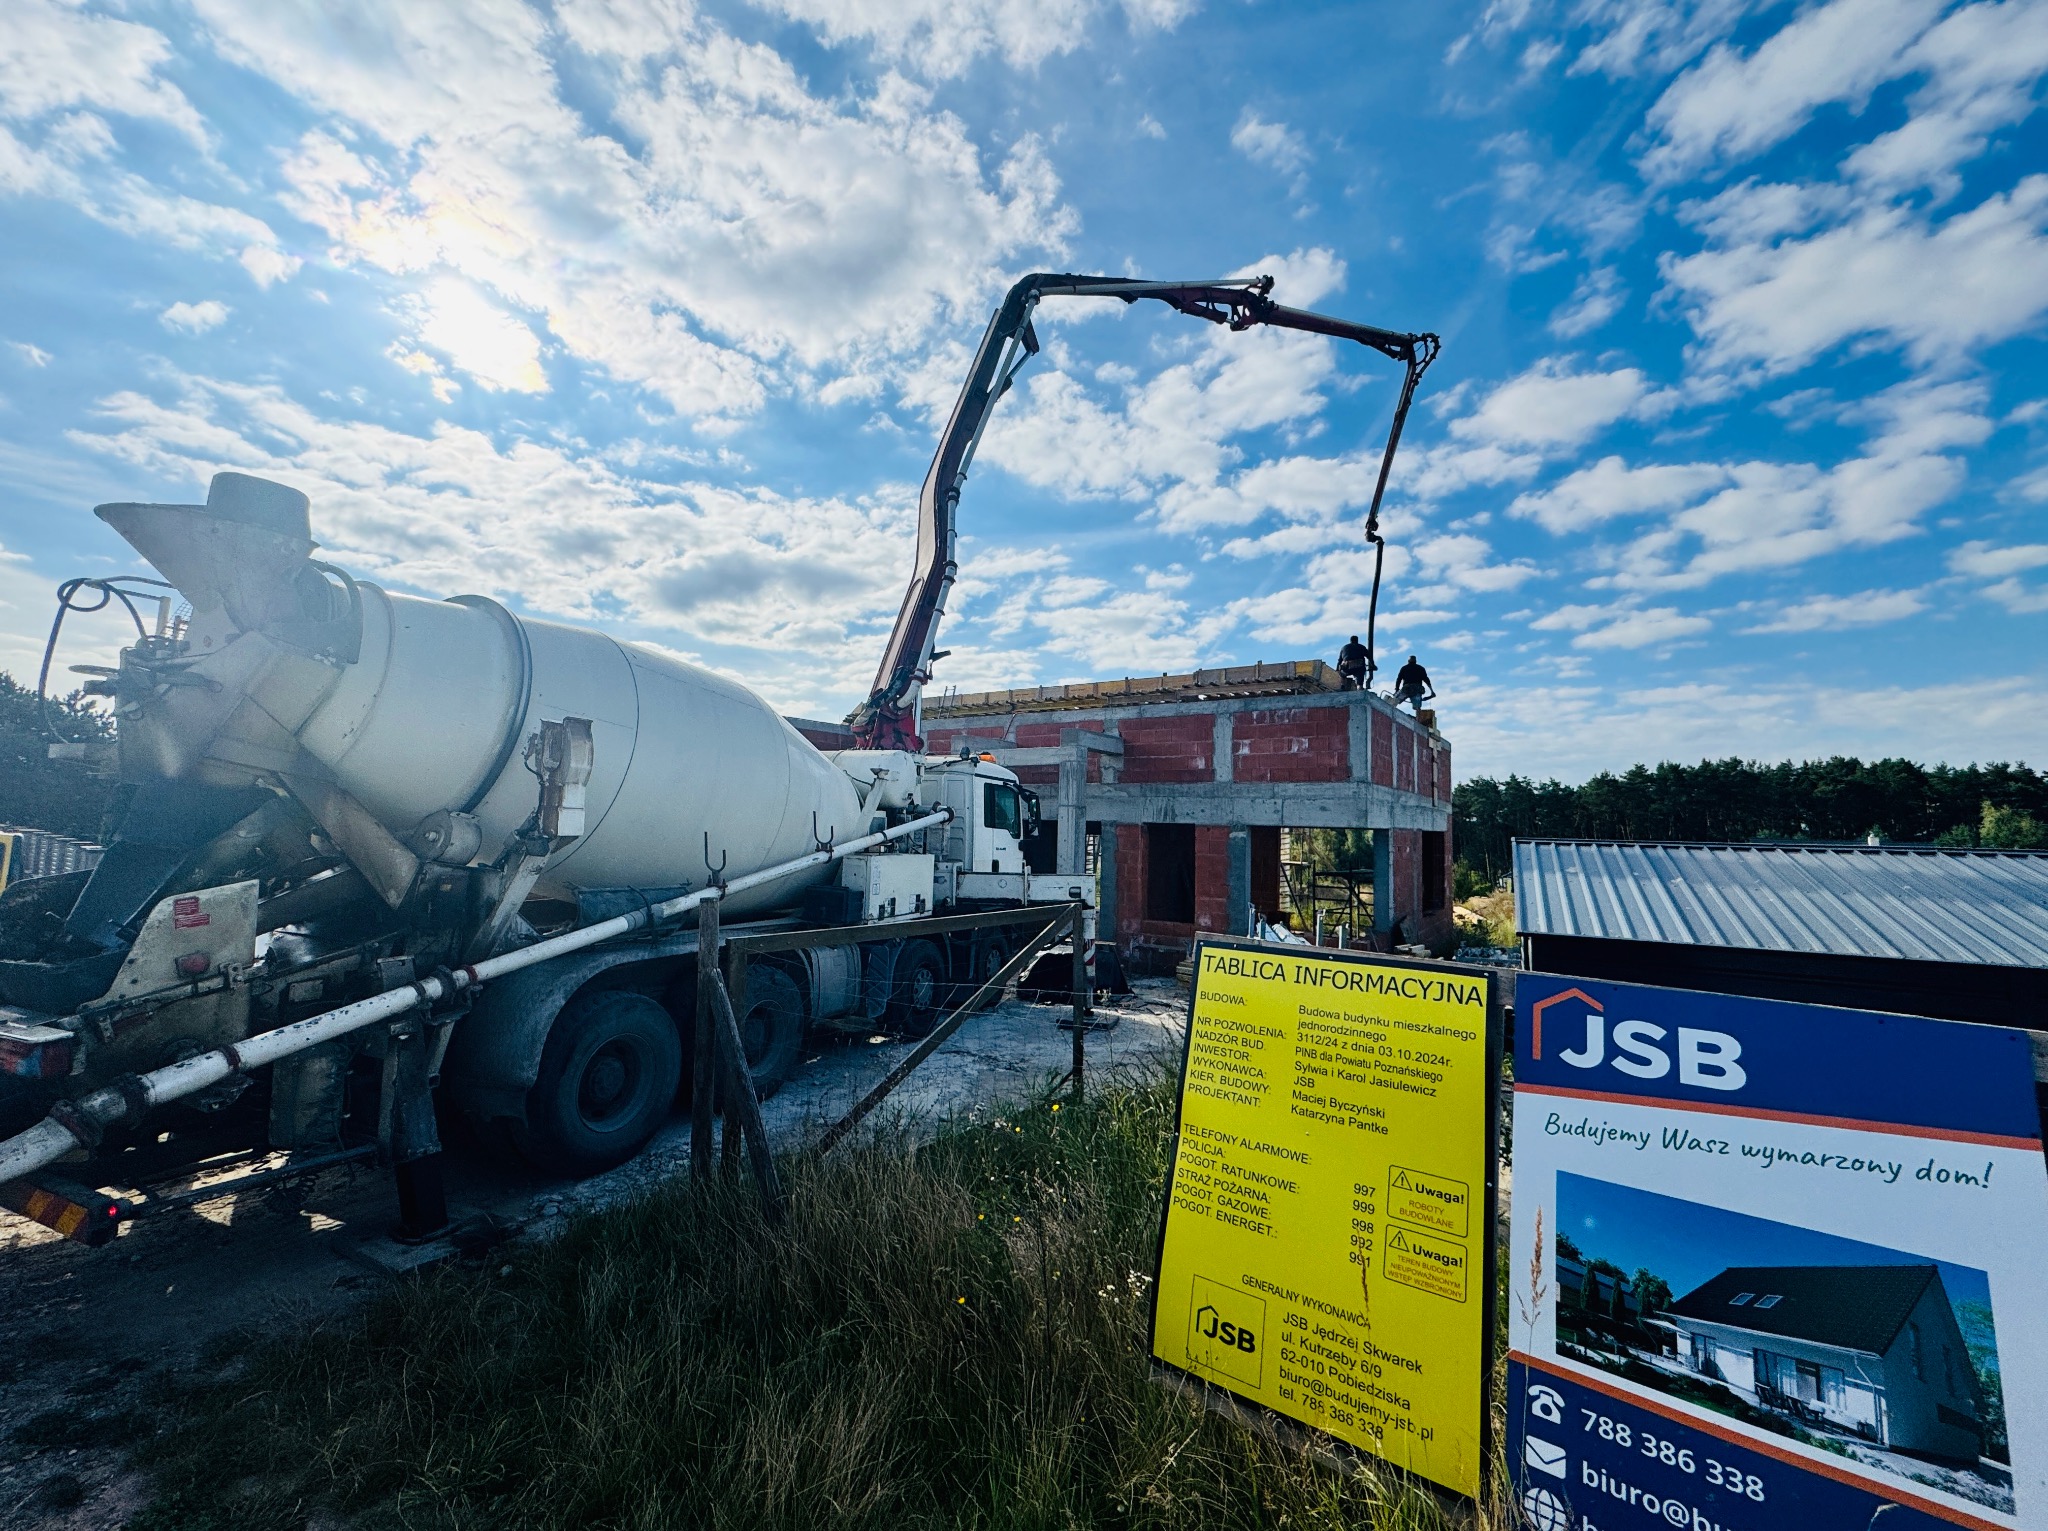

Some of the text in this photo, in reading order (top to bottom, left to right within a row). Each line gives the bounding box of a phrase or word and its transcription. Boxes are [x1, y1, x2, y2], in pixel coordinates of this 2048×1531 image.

[1204, 954, 1484, 1007] TABLICA INFORMACYJNA
[1200, 990, 1248, 1006] BUDOWA:
[1197, 1016, 1287, 1039] NR POZWOLENIA:
[1297, 1019, 1387, 1042] jednorodzinnego
[1299, 1004, 1477, 1041] Budowa budynku mieszkalnego
[1195, 1029, 1238, 1046] NADZÓR
[1297, 1032, 1453, 1068] 3112/24 z dnia 03.10.2024r.
[1194, 1043, 1252, 1062] INWESTOR:
[1295, 1046, 1443, 1083] PINB dla Powiatu Poznańskiego
[1559, 1014, 1747, 1091] JSB
[1193, 1056, 1267, 1079] WYKONAWCA:
[1293, 1076, 1315, 1088] JSB
[1294, 1061, 1437, 1098] Sylwia i Karol Jasiulewicz
[1188, 1083, 1261, 1108] PROJEKTANT:
[1220, 1075, 1271, 1095] BUDOWY:
[1292, 1090, 1386, 1119] Maciej Byczyński
[1290, 1104, 1389, 1135] Katarzyna Pantke
[1182, 1137, 1226, 1158] POLICJA:
[1184, 1123, 1312, 1165] TELEFONY ALARMOWE:
[1545, 1112, 1994, 1189] Budujemy Wasz wymarzony dom!
[1178, 1168, 1271, 1204] STRAŻ POŻARNA:
[1180, 1152, 1300, 1194] POGOT. RATUNKOWE:
[1175, 1182, 1271, 1220] POGOT. GAZOWE:
[1353, 1184, 1376, 1198] 997
[1416, 1183, 1464, 1204] Uwaga!
[1173, 1196, 1278, 1238] POGOT. ENERGET.:
[1352, 1200, 1375, 1214] 999
[1400, 1208, 1454, 1228] BUDOWLANE
[1408, 1200, 1444, 1215] ROBOTY
[1352, 1218, 1374, 1234] 998
[1350, 1234, 1373, 1250] 992
[1413, 1244, 1462, 1268] Uwaga!
[1349, 1252, 1371, 1268] 991
[1398, 1255, 1454, 1276] TEREN BUDOWY
[1242, 1274, 1371, 1330] GENERALNY WYKONAWCA
[1414, 1278, 1462, 1298] WZBRONIONY
[1203, 1316, 1256, 1353] JSB
[1283, 1312, 1422, 1374] JSB Jędrzej Skwarek
[1282, 1332, 1382, 1378] ul. Kutrzeby 6/9
[1280, 1348, 1410, 1411] 62-010 Pobiedziska
[1279, 1384, 1296, 1402] tel.
[1329, 1406, 1354, 1426] 386
[1358, 1418, 1384, 1440] 338
[1280, 1366, 1433, 1441] biuro@budujemy-jsb.pl
[1580, 1408, 1765, 1502] 788 386 338
